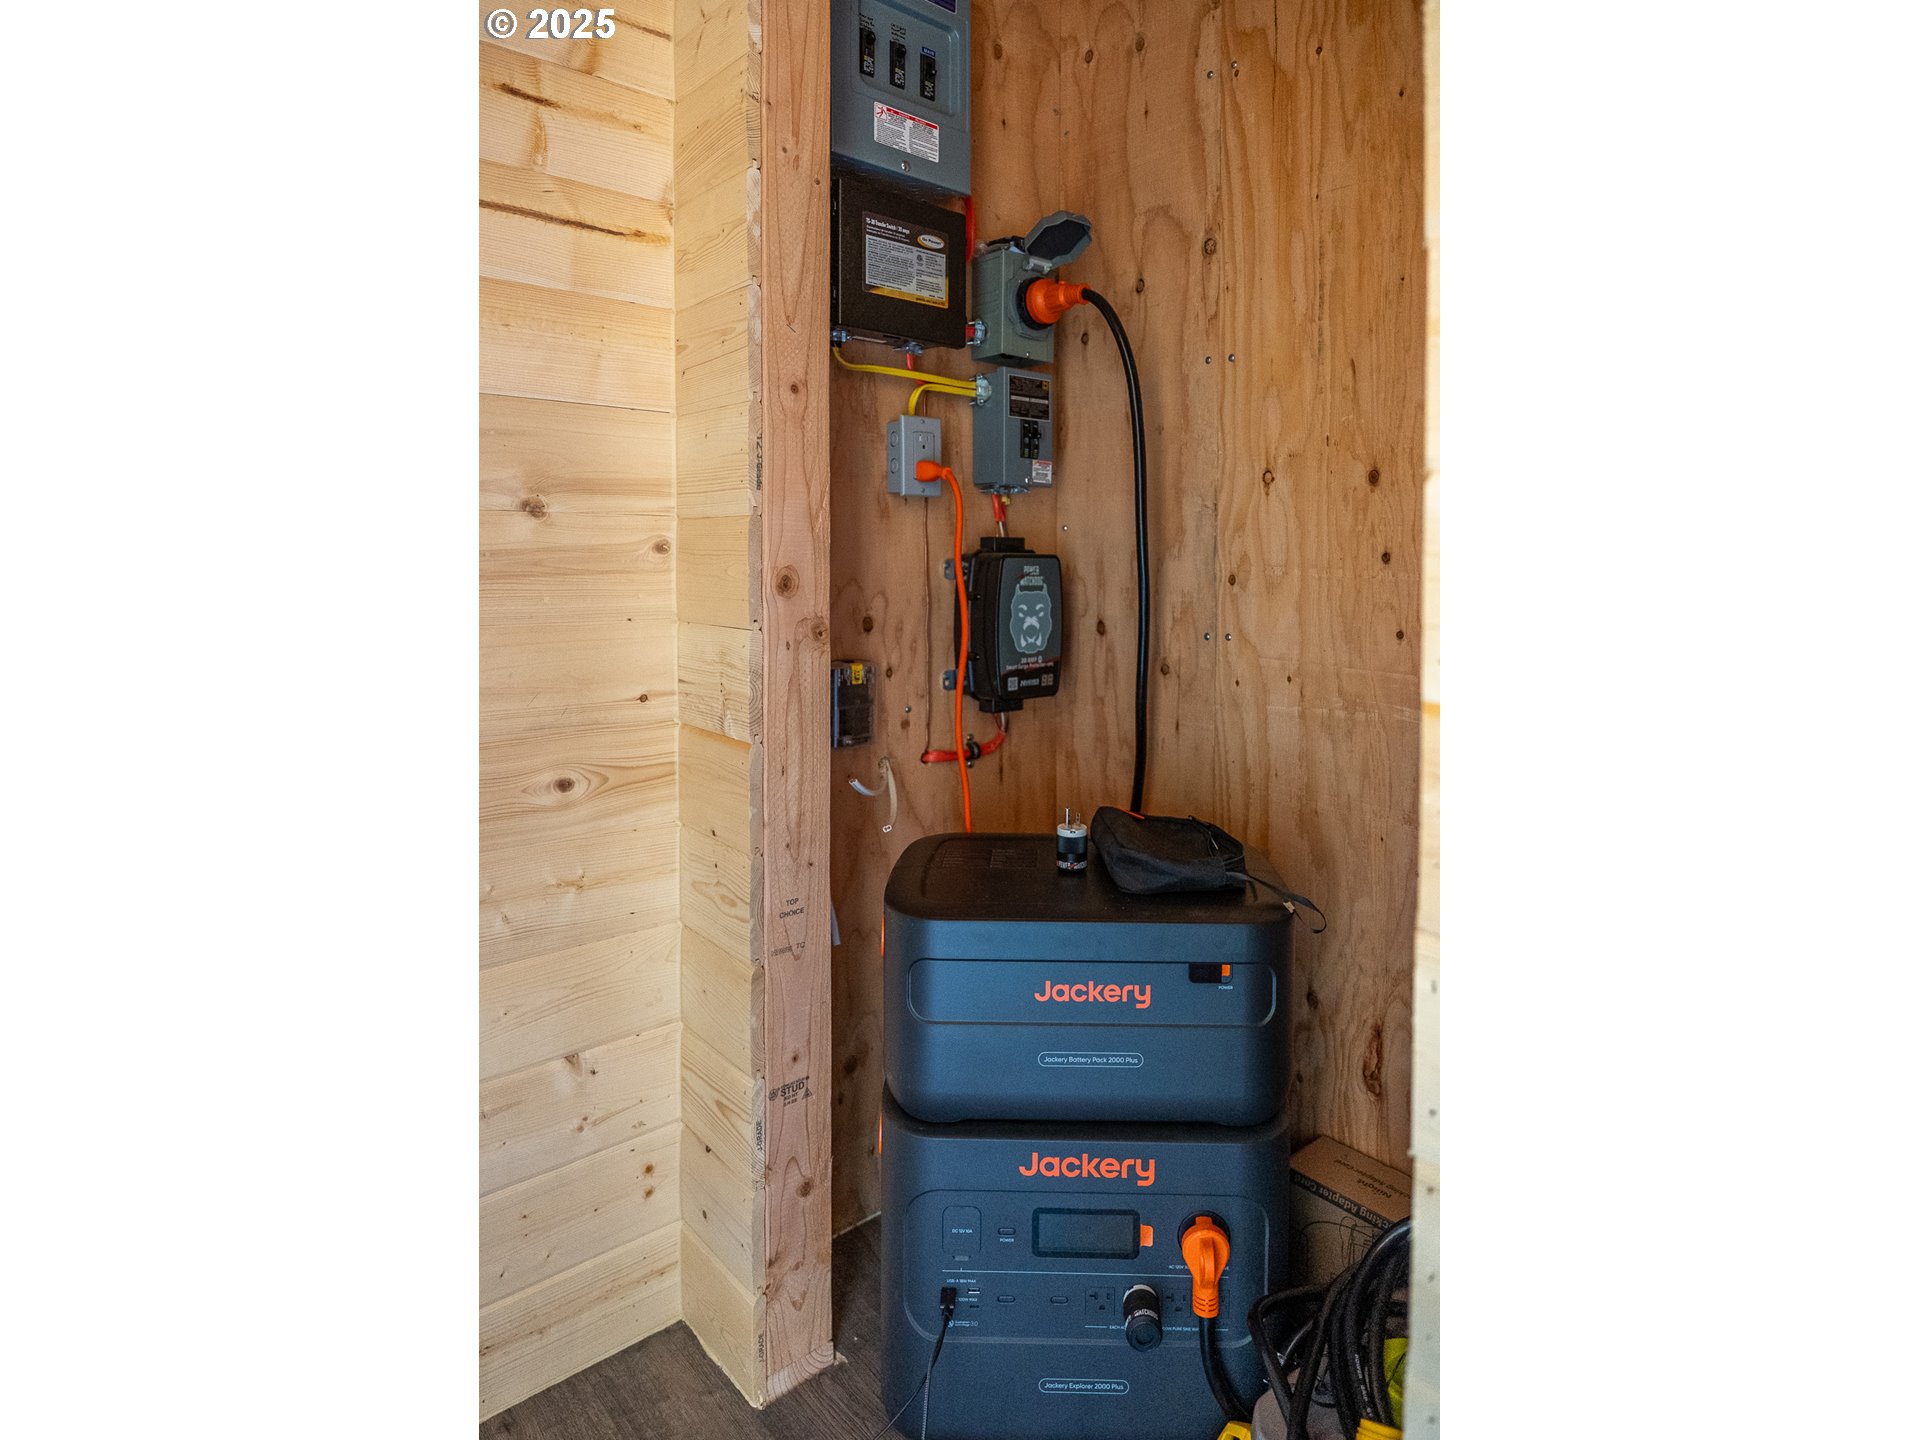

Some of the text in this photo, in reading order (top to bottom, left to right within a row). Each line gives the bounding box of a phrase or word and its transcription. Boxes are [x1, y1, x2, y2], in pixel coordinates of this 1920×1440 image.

[780, 907, 804, 918] CHOICE
[1034, 980, 1151, 1009] Jackery
[780, 1081, 805, 1097] STUD
[1018, 1152, 1155, 1186] Jackery
[1318, 1186, 1358, 1213] Adapter
[1356, 1178, 1392, 1199] Nilight
